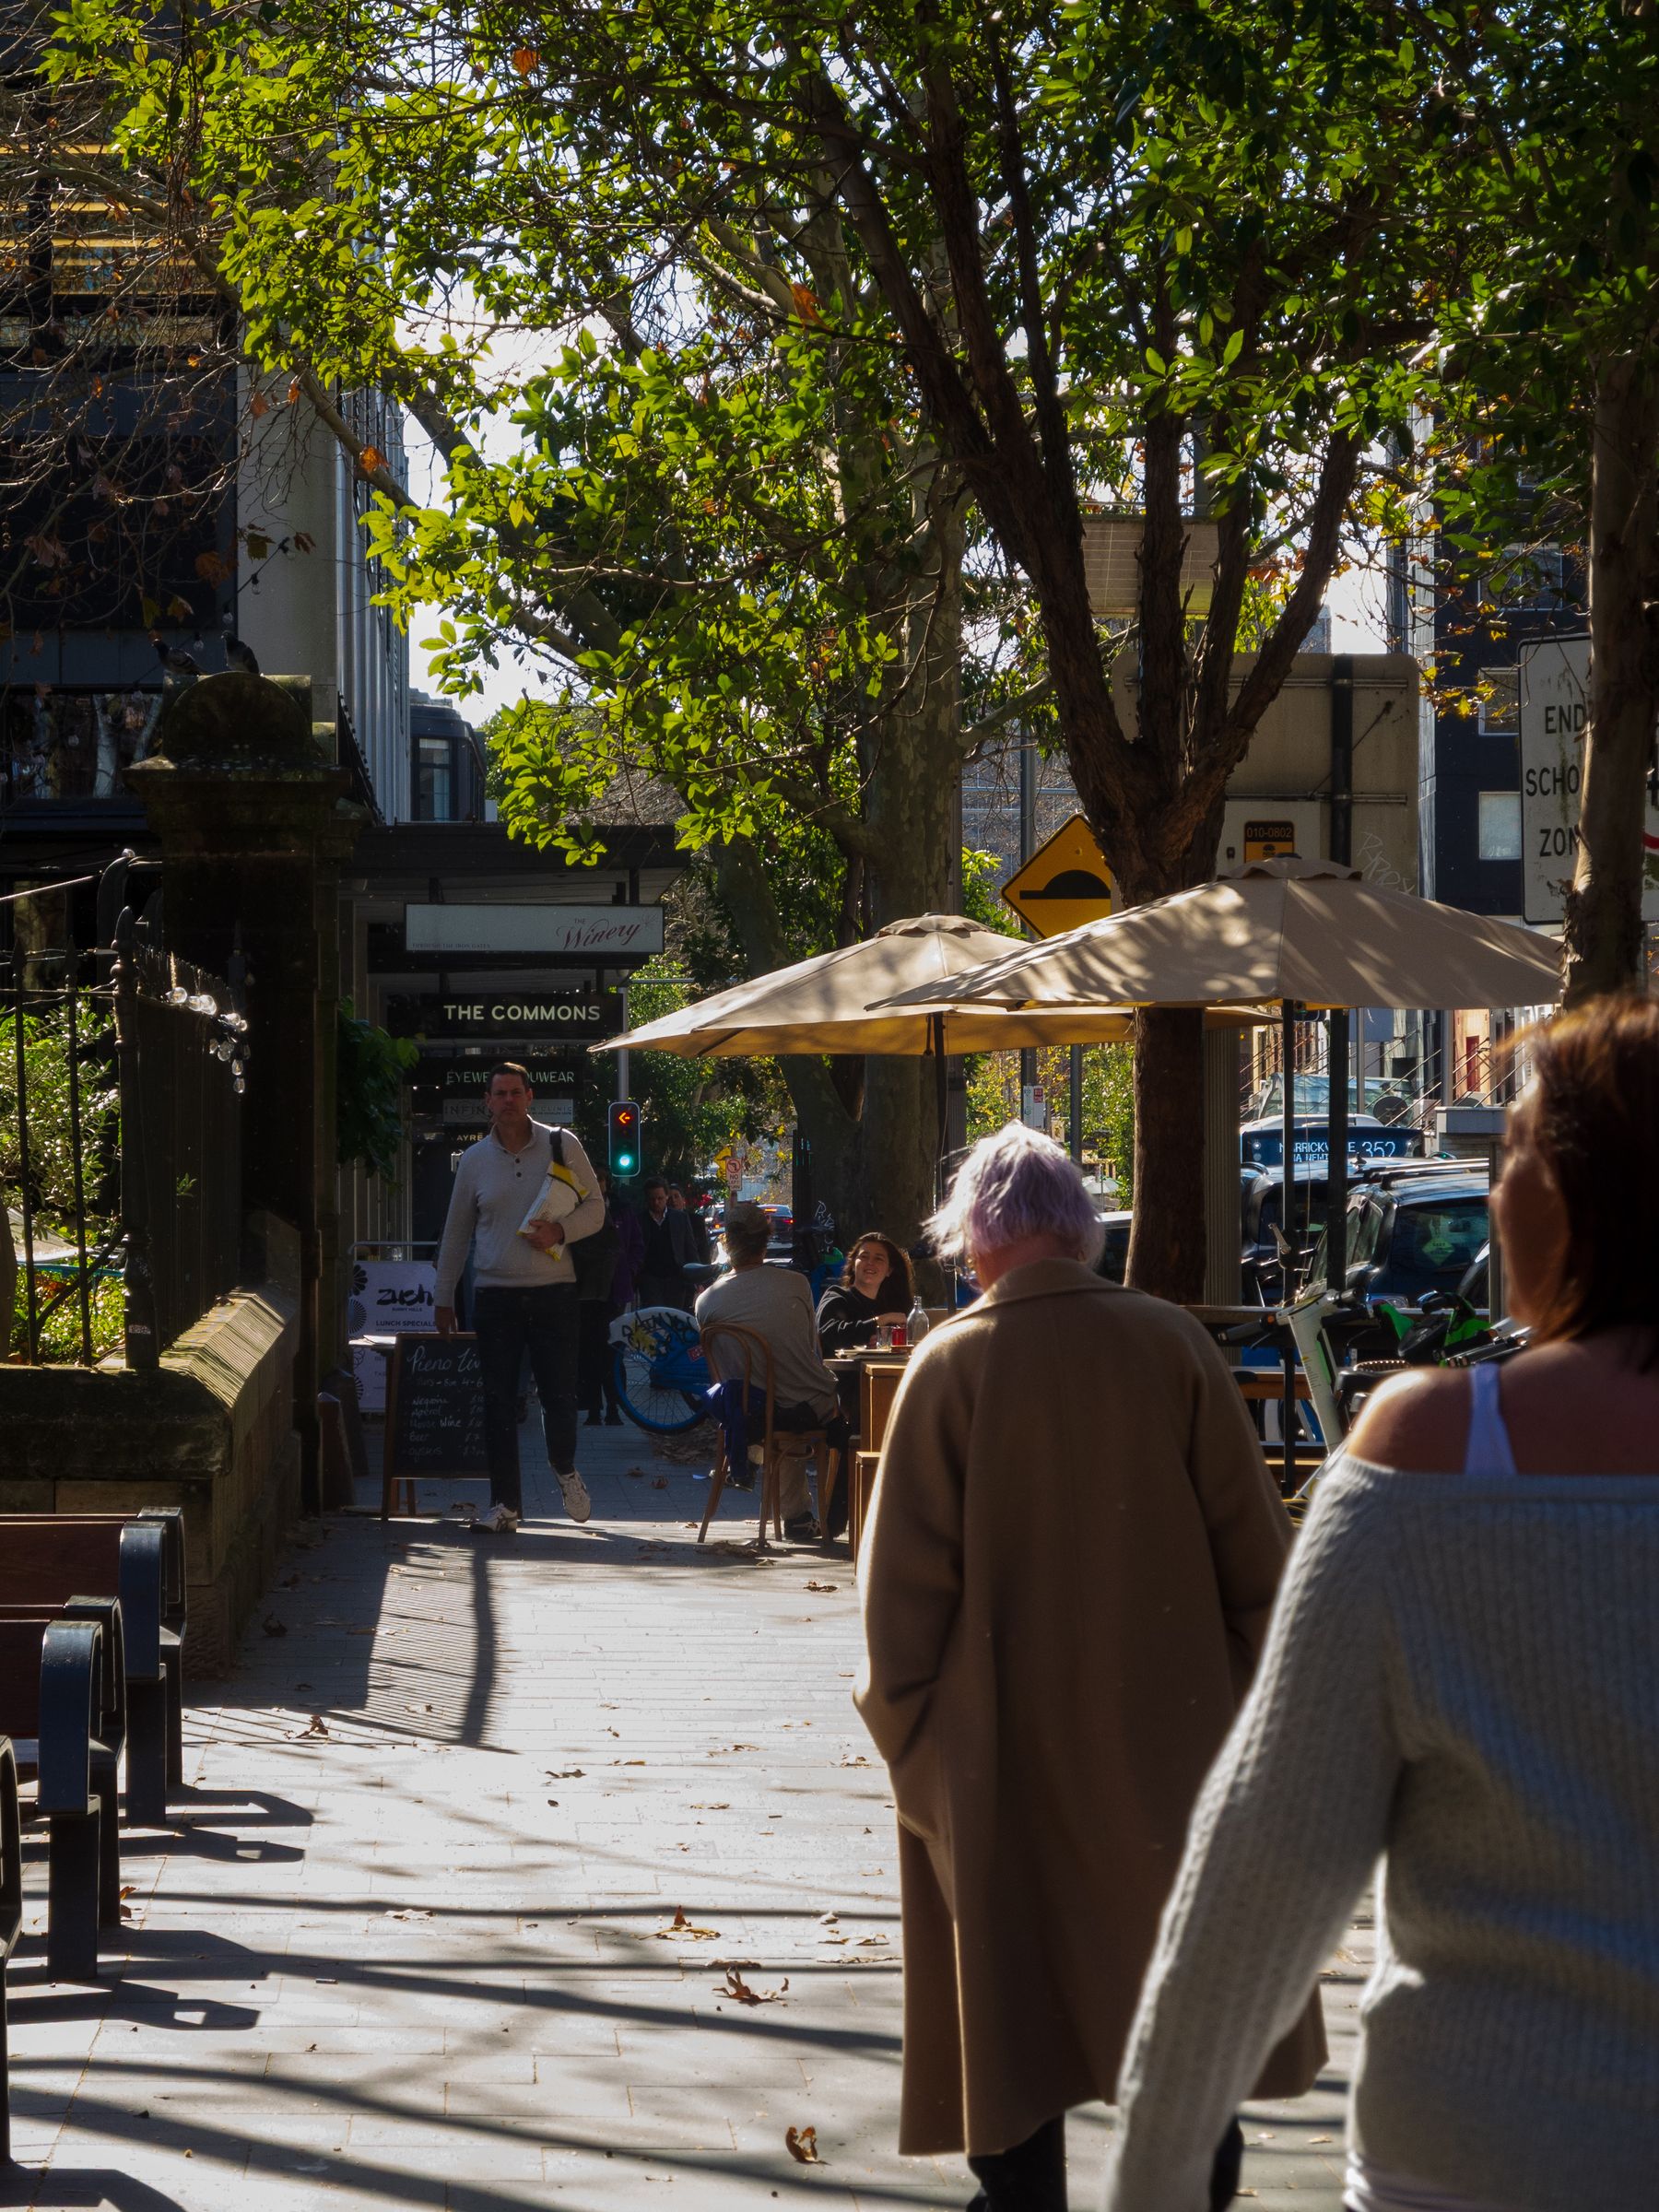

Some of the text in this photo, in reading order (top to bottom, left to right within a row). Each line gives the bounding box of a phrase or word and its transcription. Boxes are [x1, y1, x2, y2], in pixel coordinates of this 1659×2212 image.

[1545, 704, 1585, 734] END
[1525, 767, 1580, 797] SCHO
[1246, 827, 1292, 838] 010-0802
[1539, 827, 1579, 857] ZON
[555, 919, 641, 950] Winery
[443, 1005, 601, 1021] THE COMMONS
[446, 1071, 575, 1084] EYEWE UWEAR
[444, 1105, 486, 1115] INFIN
[1278, 1141, 1395, 1158] MRRICKVE 352
[376, 1284, 434, 1306] zush
[440, 1416, 463, 1428] Wine
